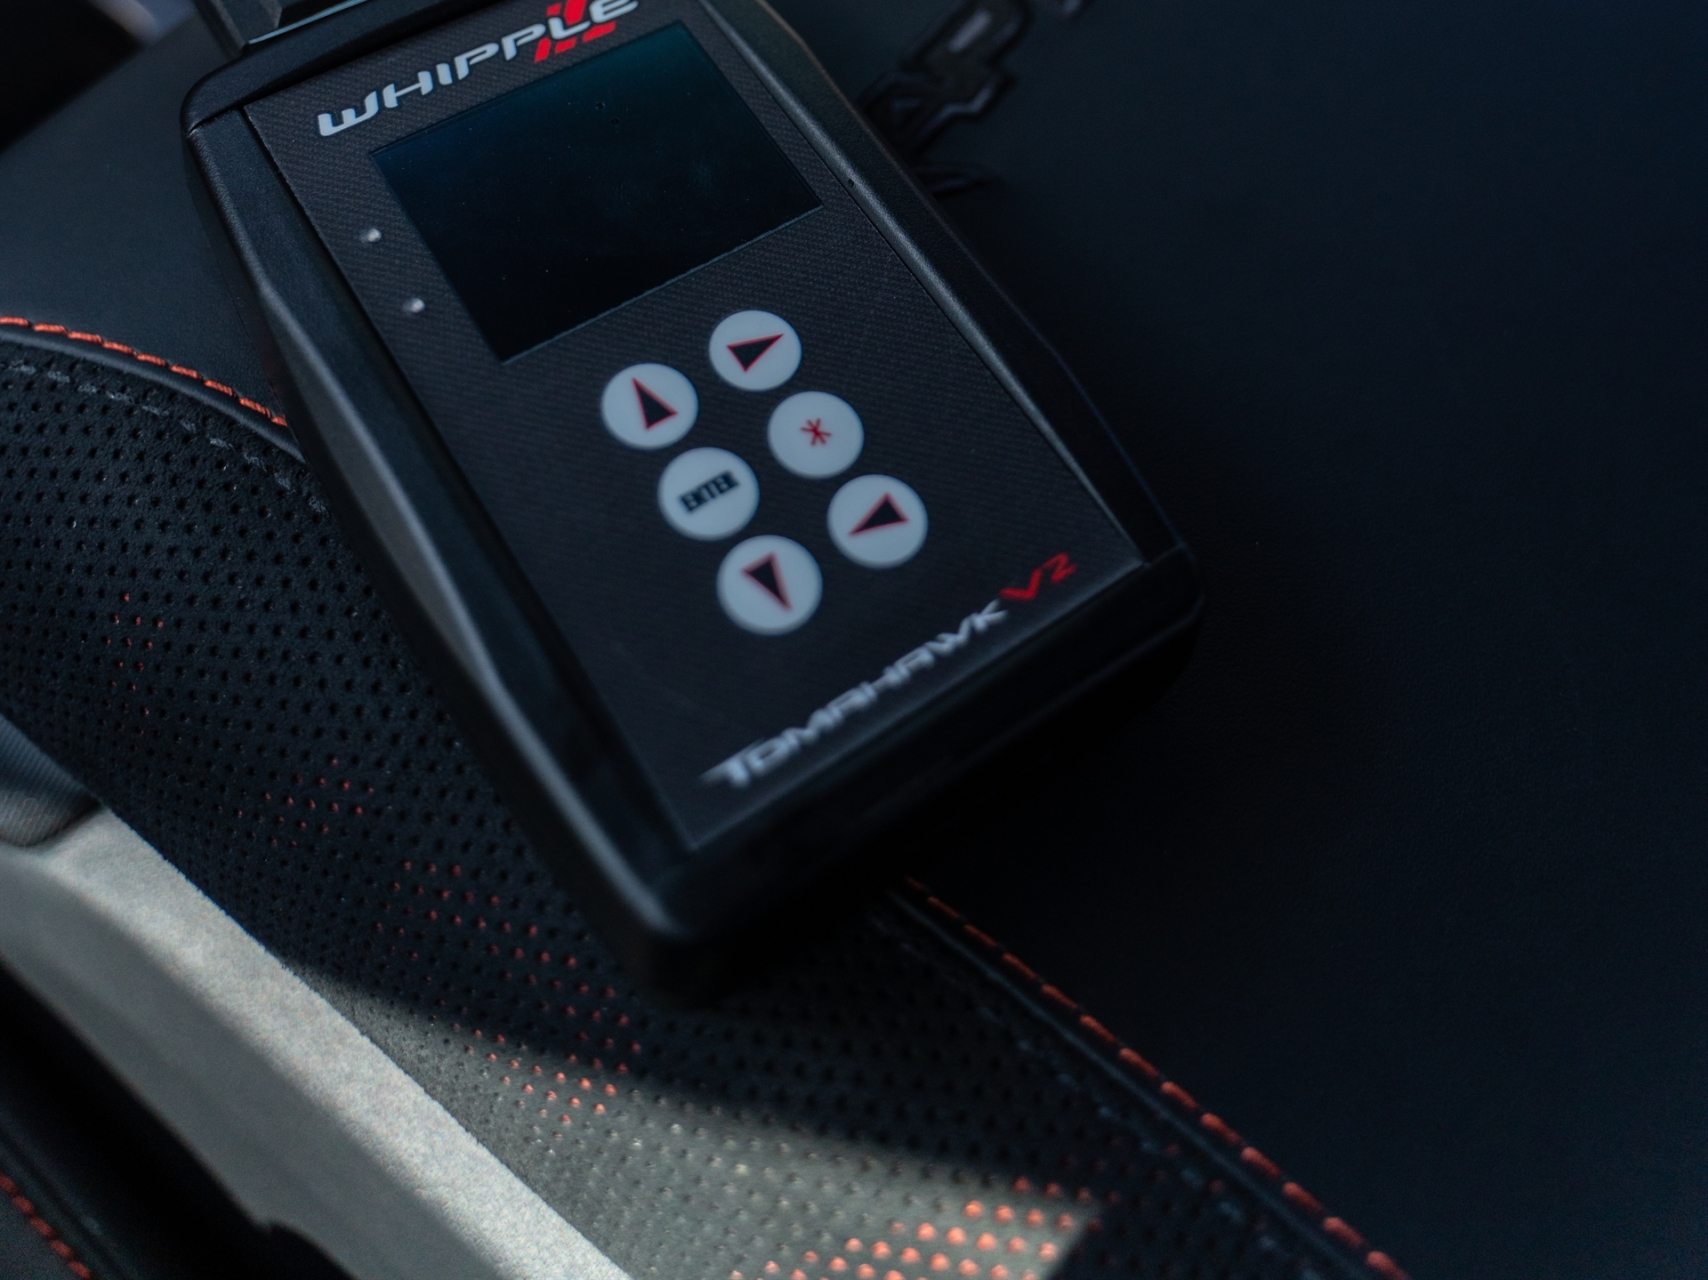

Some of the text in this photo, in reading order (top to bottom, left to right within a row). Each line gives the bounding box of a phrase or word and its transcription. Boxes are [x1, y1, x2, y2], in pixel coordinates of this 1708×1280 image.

[678, 470, 740, 512] ENTER
[700, 552, 1078, 788] TOMAHAWK V2
